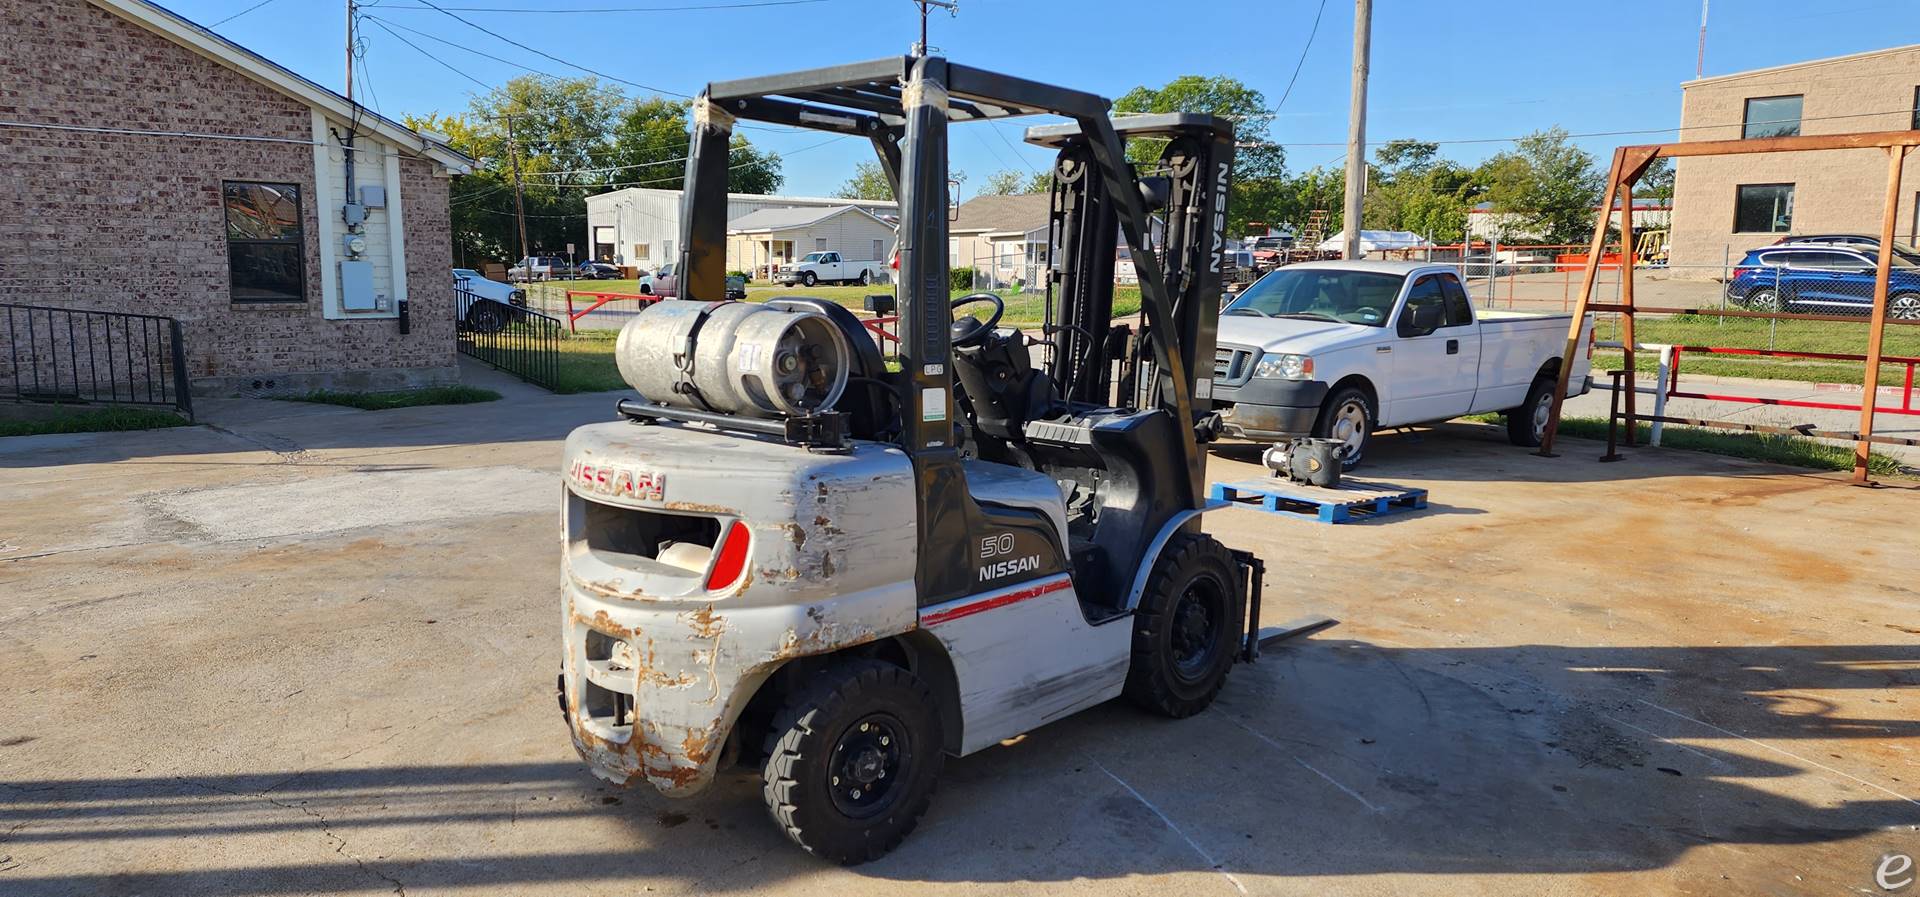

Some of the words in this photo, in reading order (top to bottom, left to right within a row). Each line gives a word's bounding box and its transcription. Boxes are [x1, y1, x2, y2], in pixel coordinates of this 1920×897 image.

[1209, 162, 1229, 273] NISSAN
[925, 365, 943, 375] LPG
[1839, 384, 1852, 392] NO
[1855, 384, 1892, 394] PAING
[980, 533, 1015, 558] 50
[978, 554, 1040, 582] NISSAN
